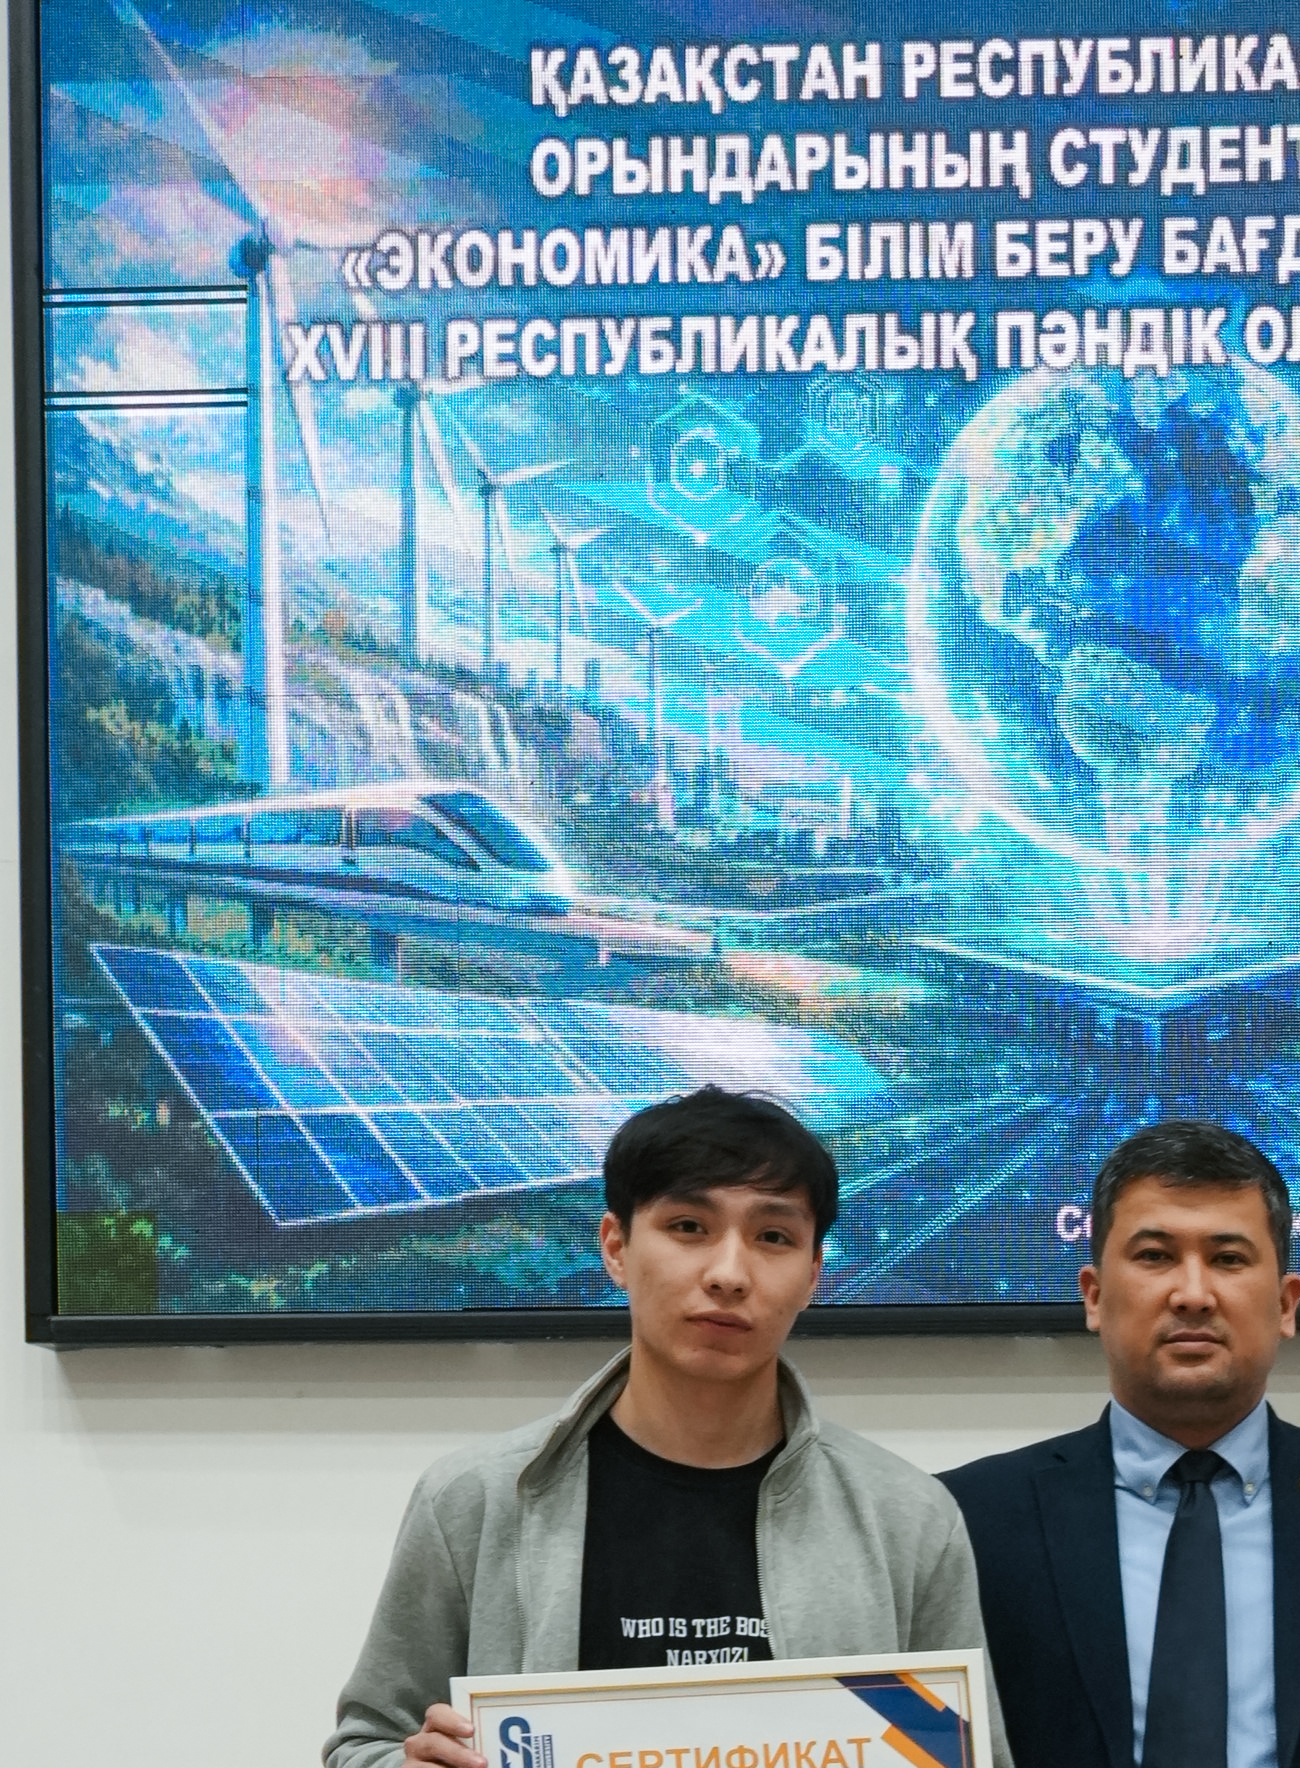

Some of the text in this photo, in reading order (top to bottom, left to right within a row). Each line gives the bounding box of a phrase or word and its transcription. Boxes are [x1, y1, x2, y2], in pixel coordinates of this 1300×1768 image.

[530, 43, 882, 117] ҚАЗАҚСТАН
[530, 129, 1031, 203] ОРЫНДАРЫНЫҢ
[342, 223, 786, 291] «ЭКОНОМИКА»
[806, 221, 975, 283] БІЛІМ
[997, 217, 1142, 280] БЕРУ
[284, 319, 426, 384] XVIII
[447, 311, 981, 391] РЕСПУБЛИКАЛЫҚ
[997, 305, 1226, 378] ПӘНДІК
[620, 1616, 771, 1638] WHO IS THE BOS
